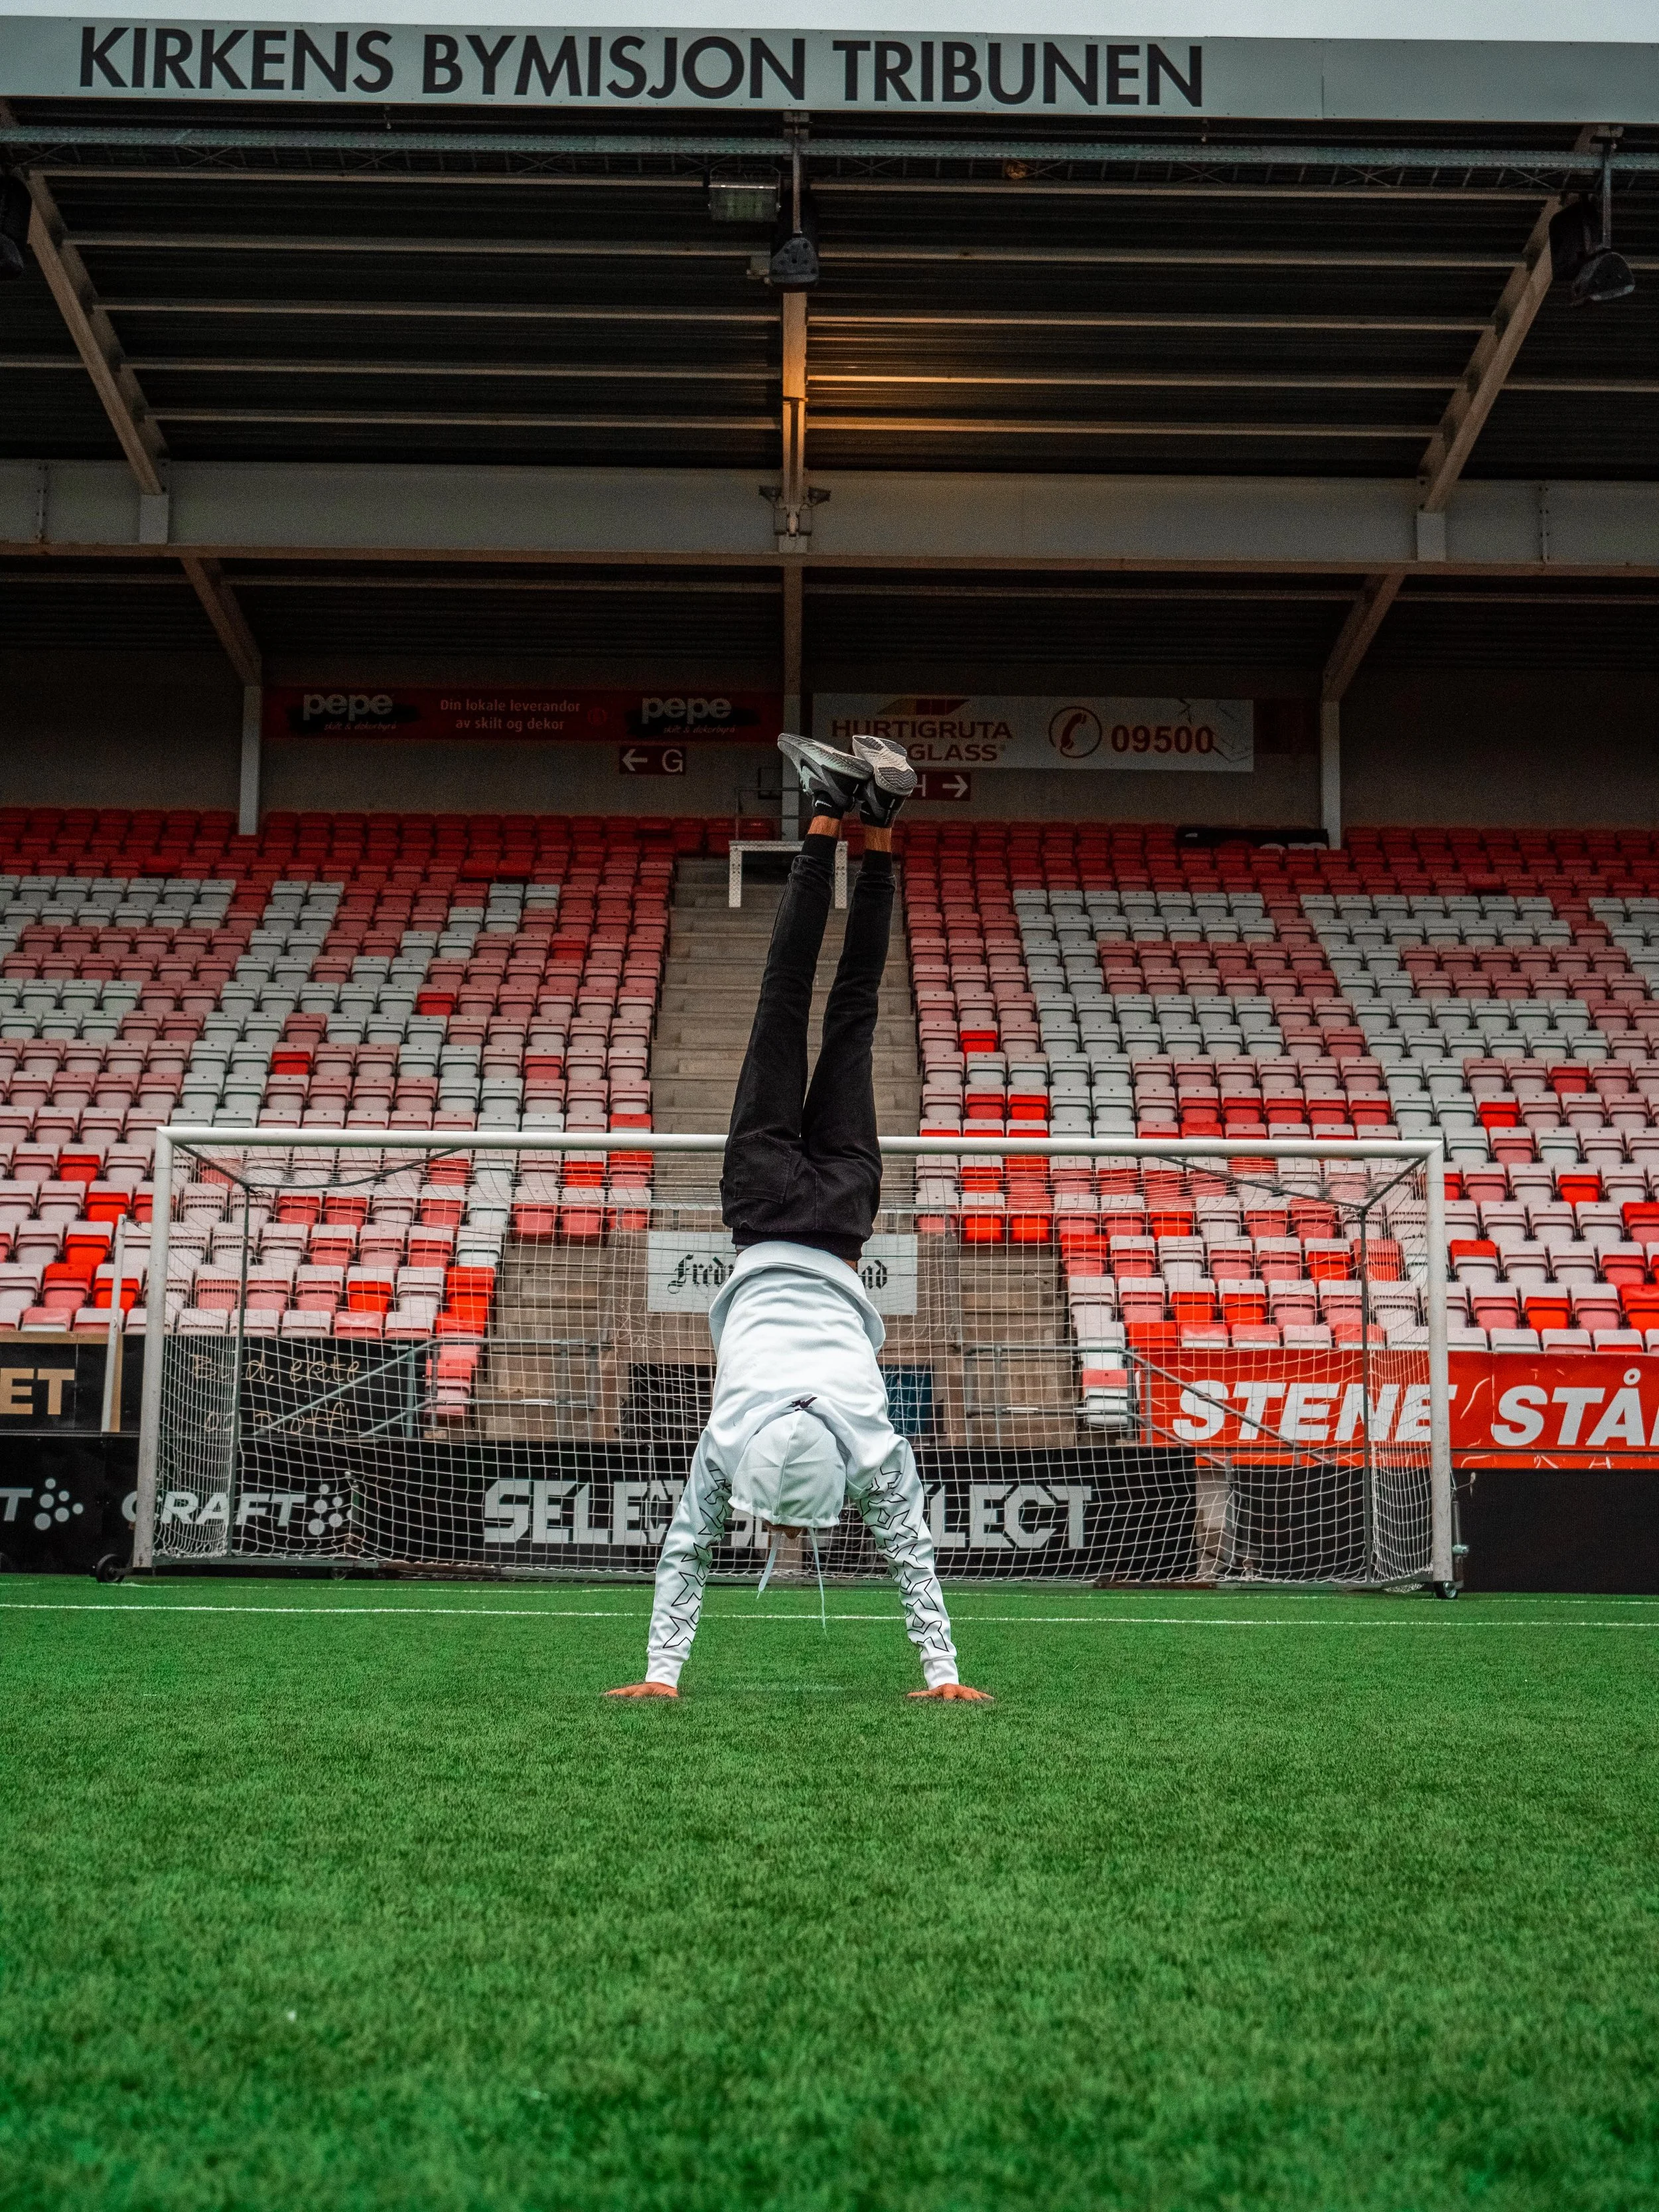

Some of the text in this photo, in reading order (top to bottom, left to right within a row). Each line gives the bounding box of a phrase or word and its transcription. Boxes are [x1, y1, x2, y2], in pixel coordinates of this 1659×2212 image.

[80, 27, 1202, 108] KIRKENS BYMISJON TRIBUNEN
[303, 694, 394, 721] pepe
[440, 699, 461, 711] Din
[466, 698, 506, 711] lokale
[641, 697, 732, 725] pepe
[455, 717, 564, 733] av skilt og dekor
[831, 720, 1013, 739] HURTIGRUTA
[1112, 725, 1214, 753] 09500
[662, 748, 684, 773] G
[0, 1368, 75, 1415] ET
[1172, 1368, 1659, 1447] STENE STÅ
